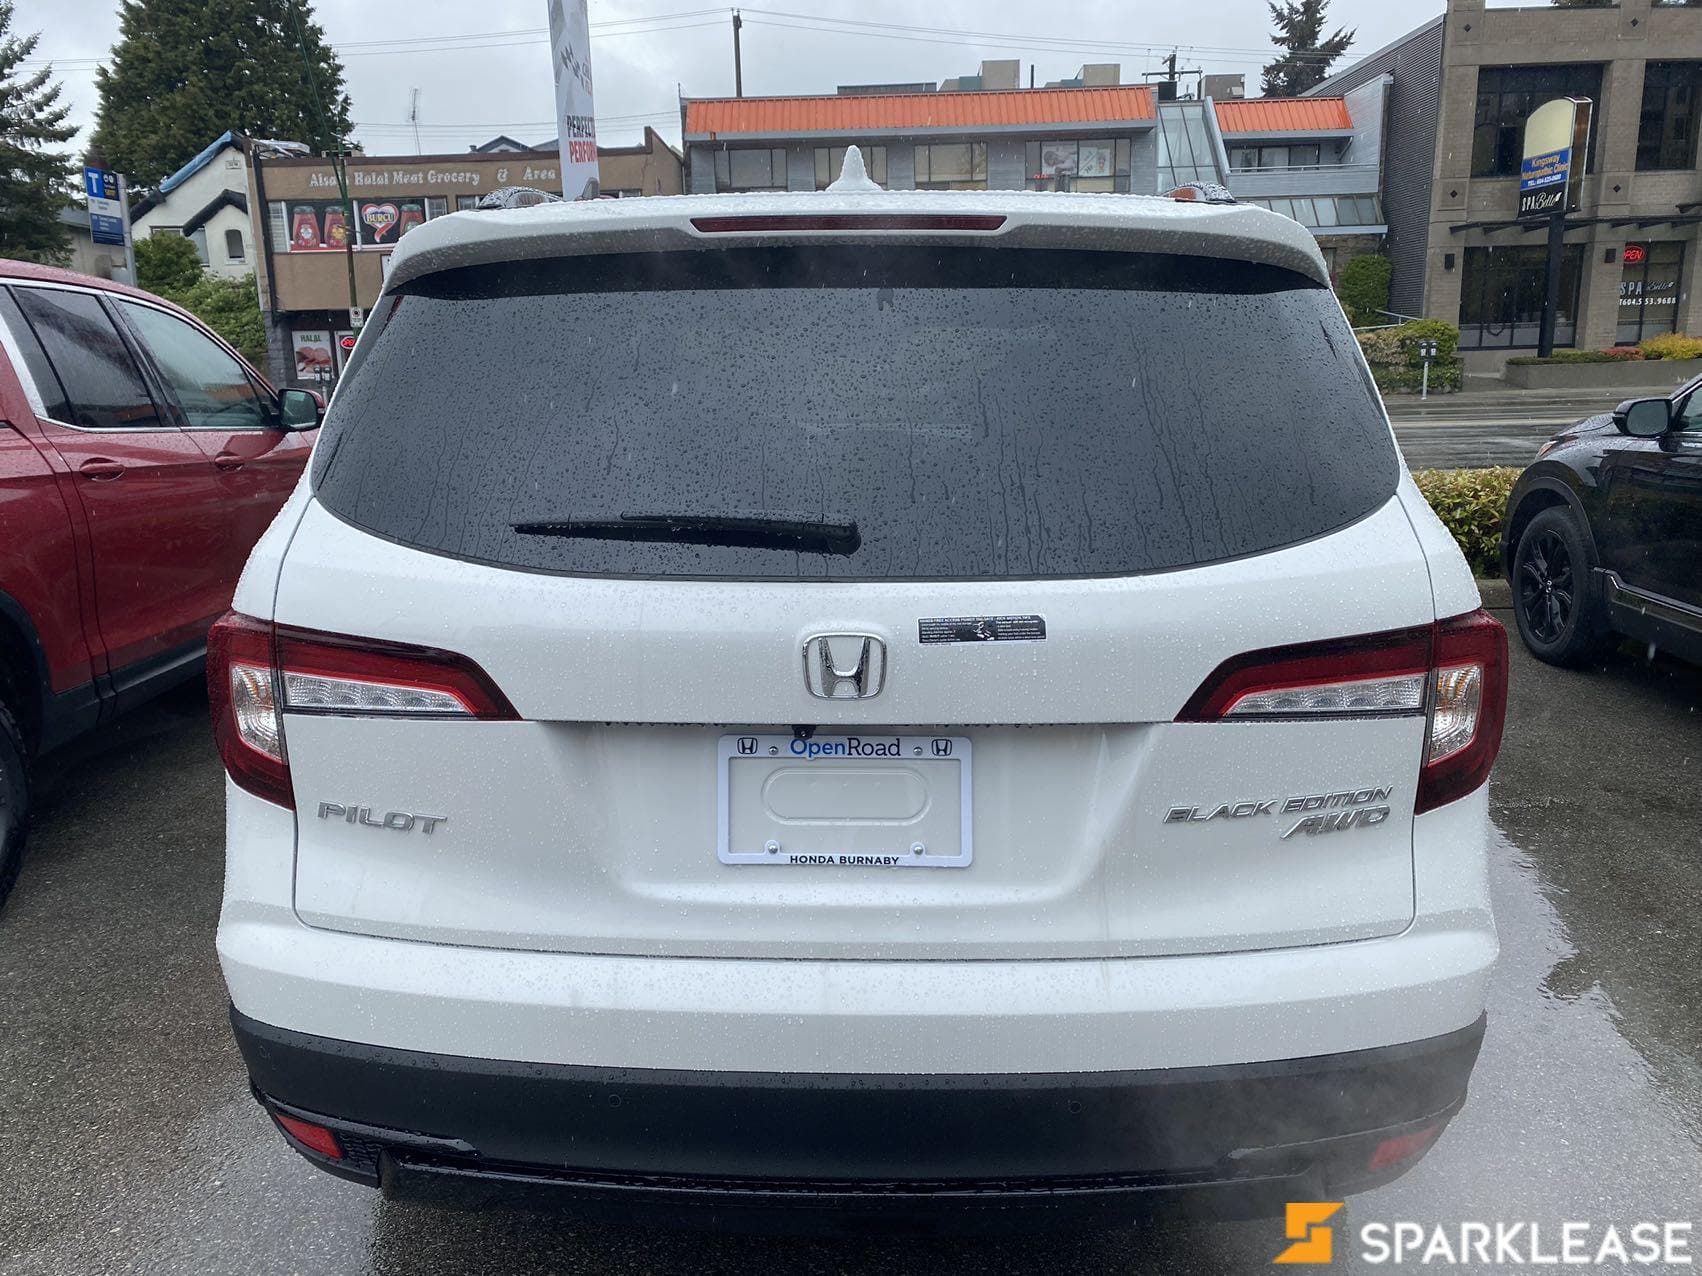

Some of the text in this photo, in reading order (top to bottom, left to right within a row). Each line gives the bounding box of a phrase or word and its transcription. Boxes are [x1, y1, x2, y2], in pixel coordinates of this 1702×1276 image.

[1532, 153, 1560, 168] Kingsway
[354, 171, 389, 186] Halal
[392, 170, 424, 184] Meat
[427, 169, 480, 186] Grocery
[497, 168, 508, 183] &
[523, 166, 556, 181] Area
[1521, 195, 1536, 211] SPA
[366, 212, 395, 223] BURCU
[1620, 281, 1642, 296] SPA
[790, 737, 902, 758] OpenRoad
[1163, 784, 1394, 824] BLACK EDITION
[317, 800, 448, 835] PILOT
[1279, 804, 1391, 841] AWD
[789, 855, 900, 866] HONDA BURNABY
